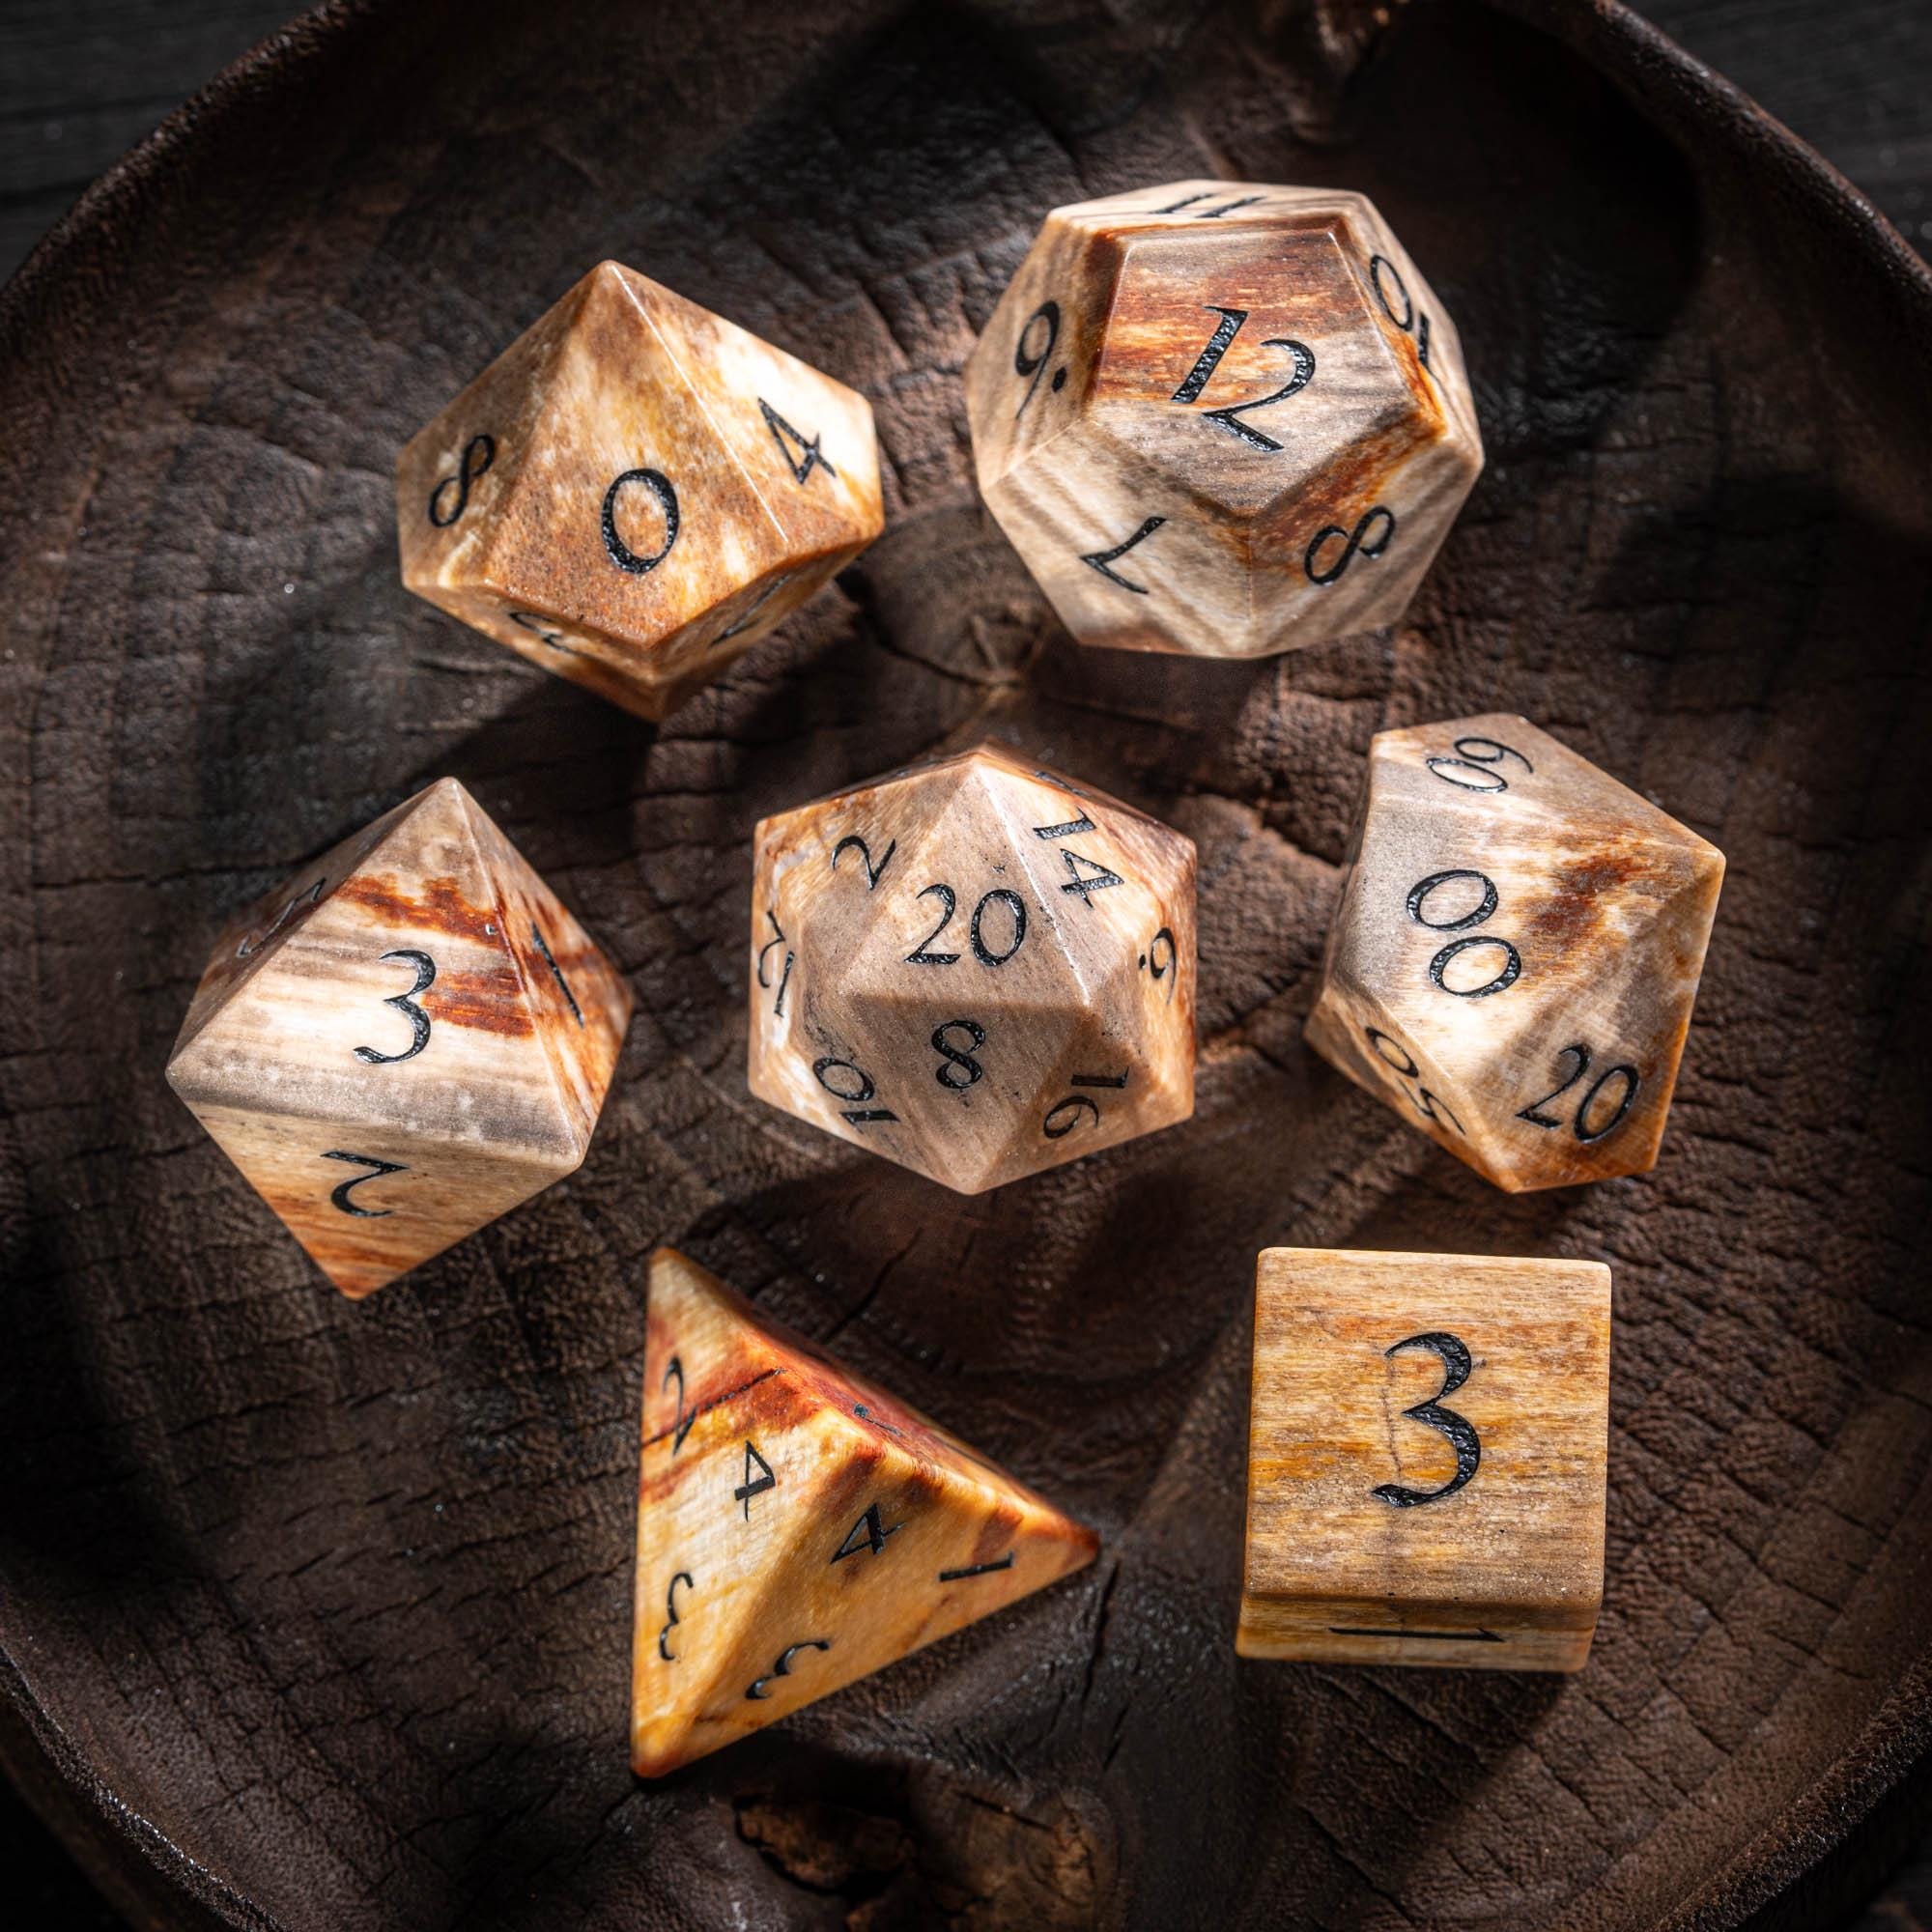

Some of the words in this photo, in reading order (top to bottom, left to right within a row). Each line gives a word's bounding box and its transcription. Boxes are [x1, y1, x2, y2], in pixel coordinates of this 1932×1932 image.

[1170, 305, 1317, 453] 12
[429, 434, 497, 528] 8
[757, 397, 837, 484] 4
[601, 469, 680, 575] 0
[1304, 505, 1397, 587] 8
[832, 836, 896, 891] 2
[1032, 808, 1124, 909] 14
[904, 883, 1028, 966] 20
[1406, 869, 1523, 999] 00
[353, 950, 437, 1064] 3
[531, 921, 585, 1030] 1
[812, 1057, 901, 1134] 10
[931, 1020, 985, 1090] 8
[1516, 1043, 1640, 1145] 20
[1043, 1065, 1130, 1140] 16
[321, 1151, 410, 1218] 2
[1371, 1331, 1481, 1508] 3
[734, 1440, 777, 1522] 4
[830, 1503, 908, 1565] 4
[939, 1550, 1015, 1582] 1
[659, 1571, 694, 1662] 3
[745, 1640, 831, 1701] 3
